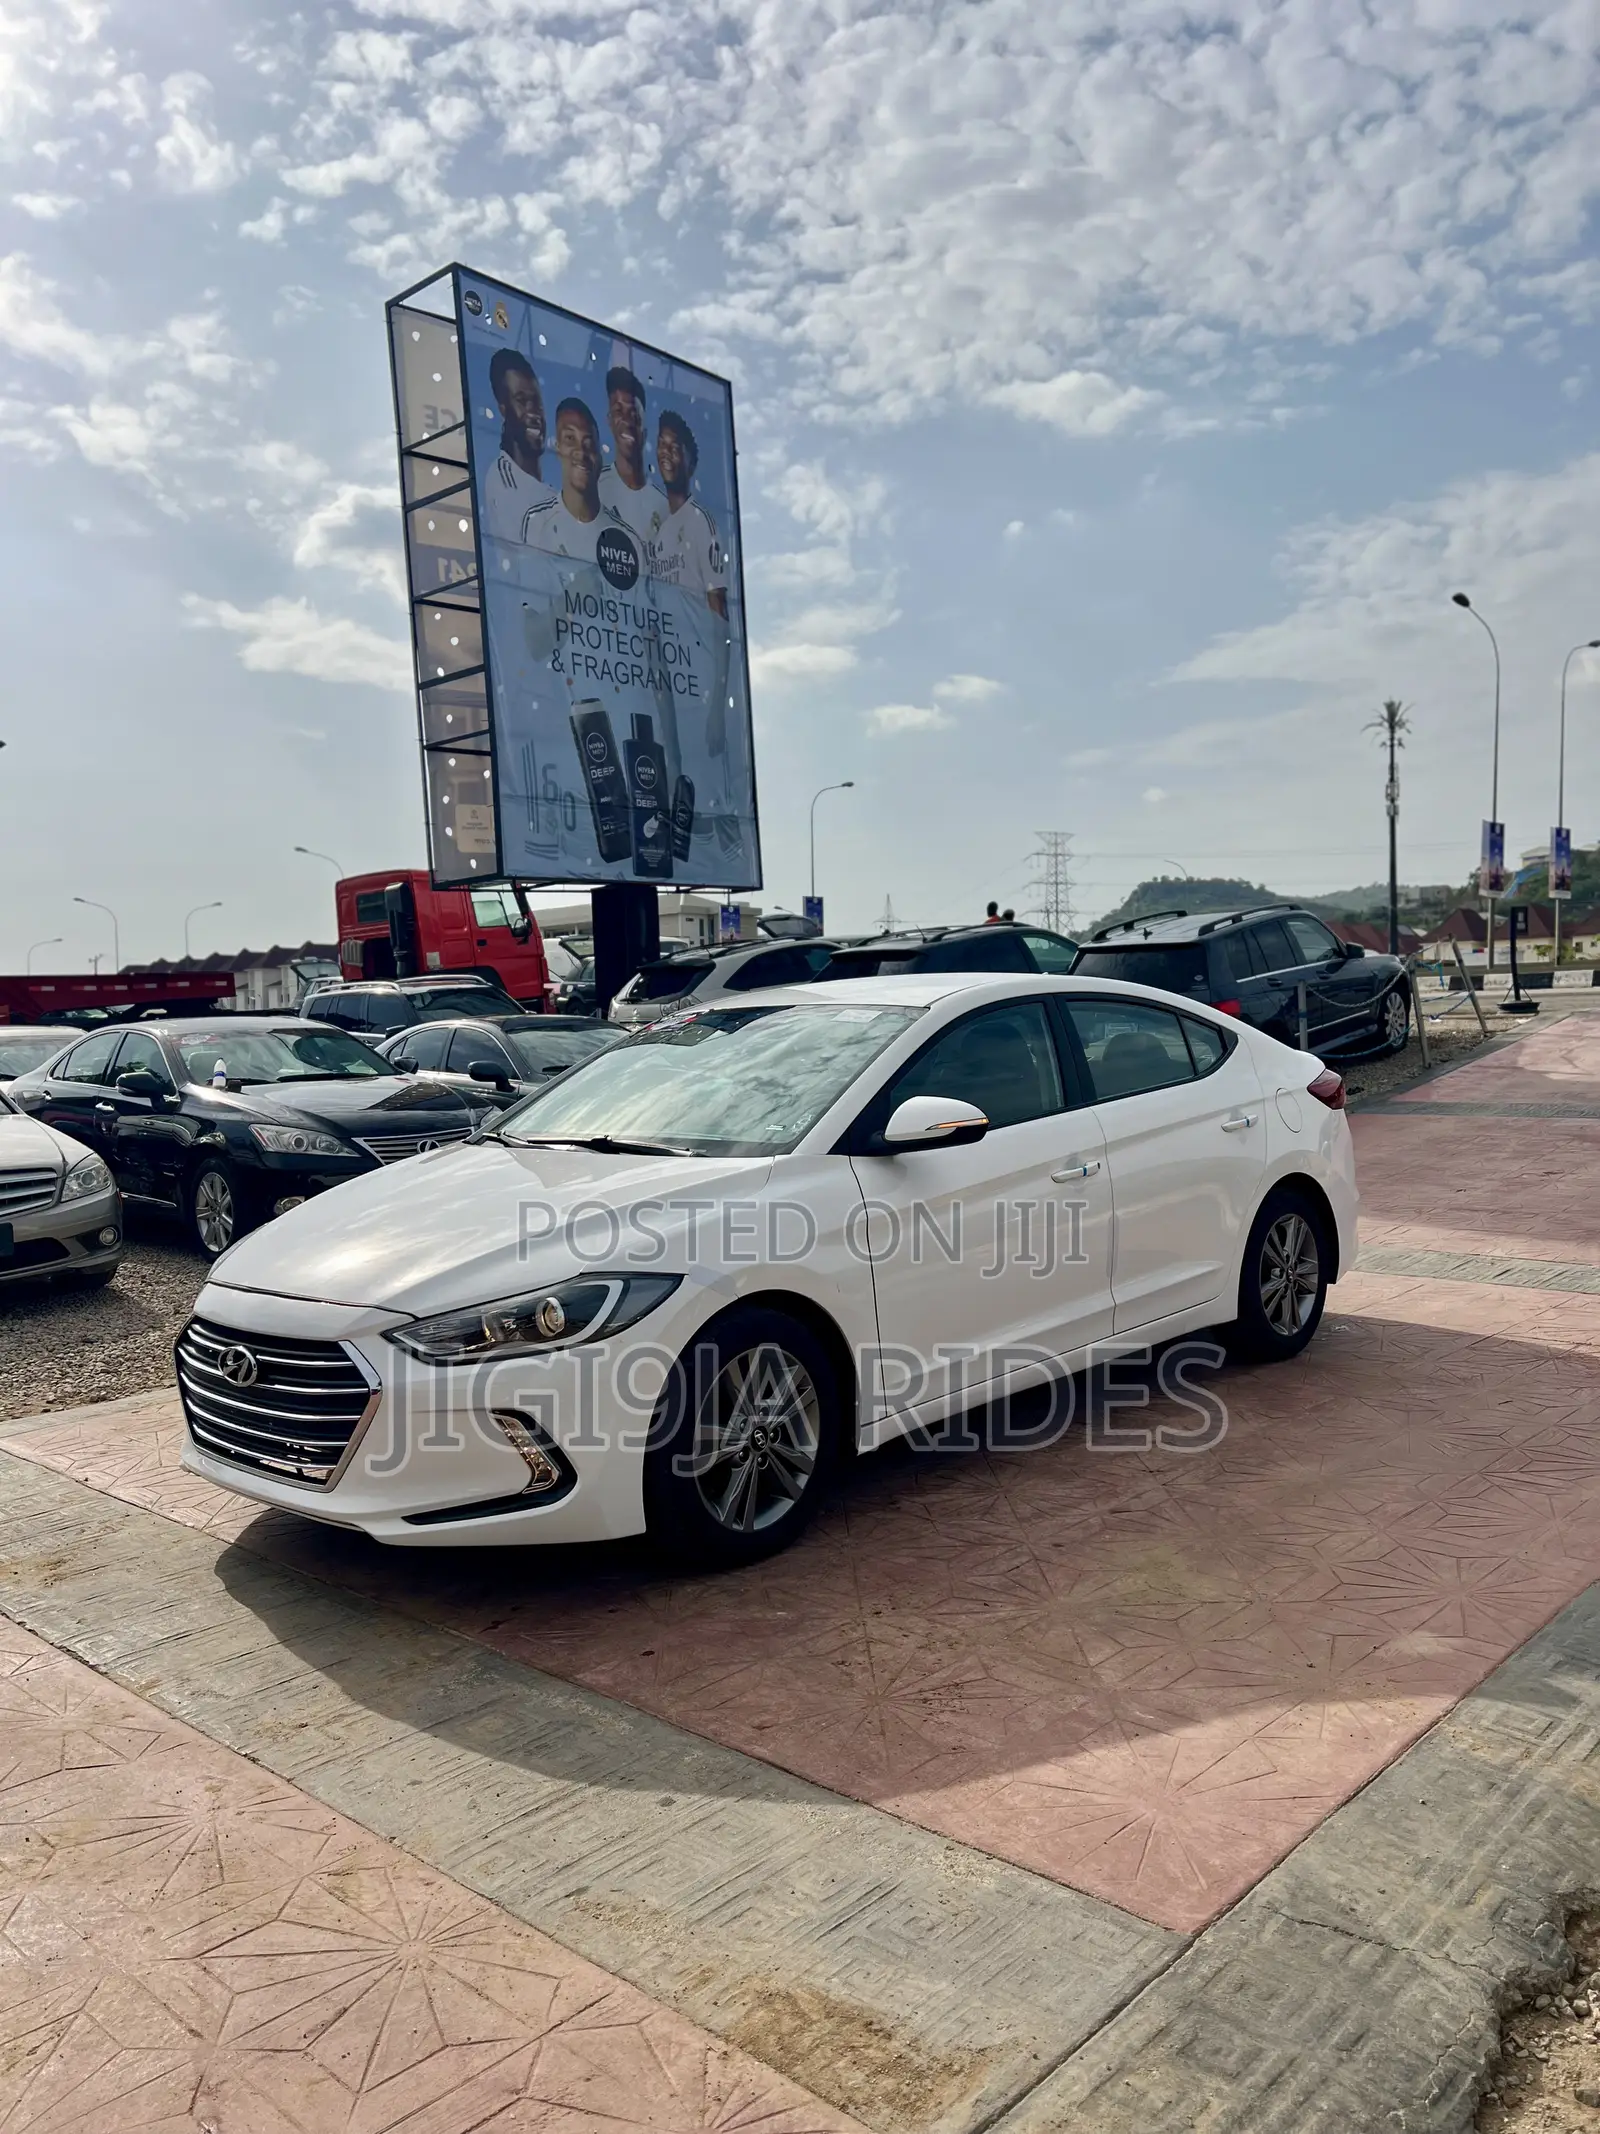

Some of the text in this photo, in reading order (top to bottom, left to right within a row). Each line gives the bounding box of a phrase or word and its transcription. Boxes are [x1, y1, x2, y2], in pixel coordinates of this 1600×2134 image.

[600, 545, 636, 566] NIVEA
[606, 561, 631, 577] MEN
[564, 589, 680, 640] MOISTURE,
[555, 618, 692, 668] PROTECTION
[551, 648, 700, 697] & FRAGRANCE
[590, 766, 615, 779] DEEP
[636, 798, 658, 808] DEEP
